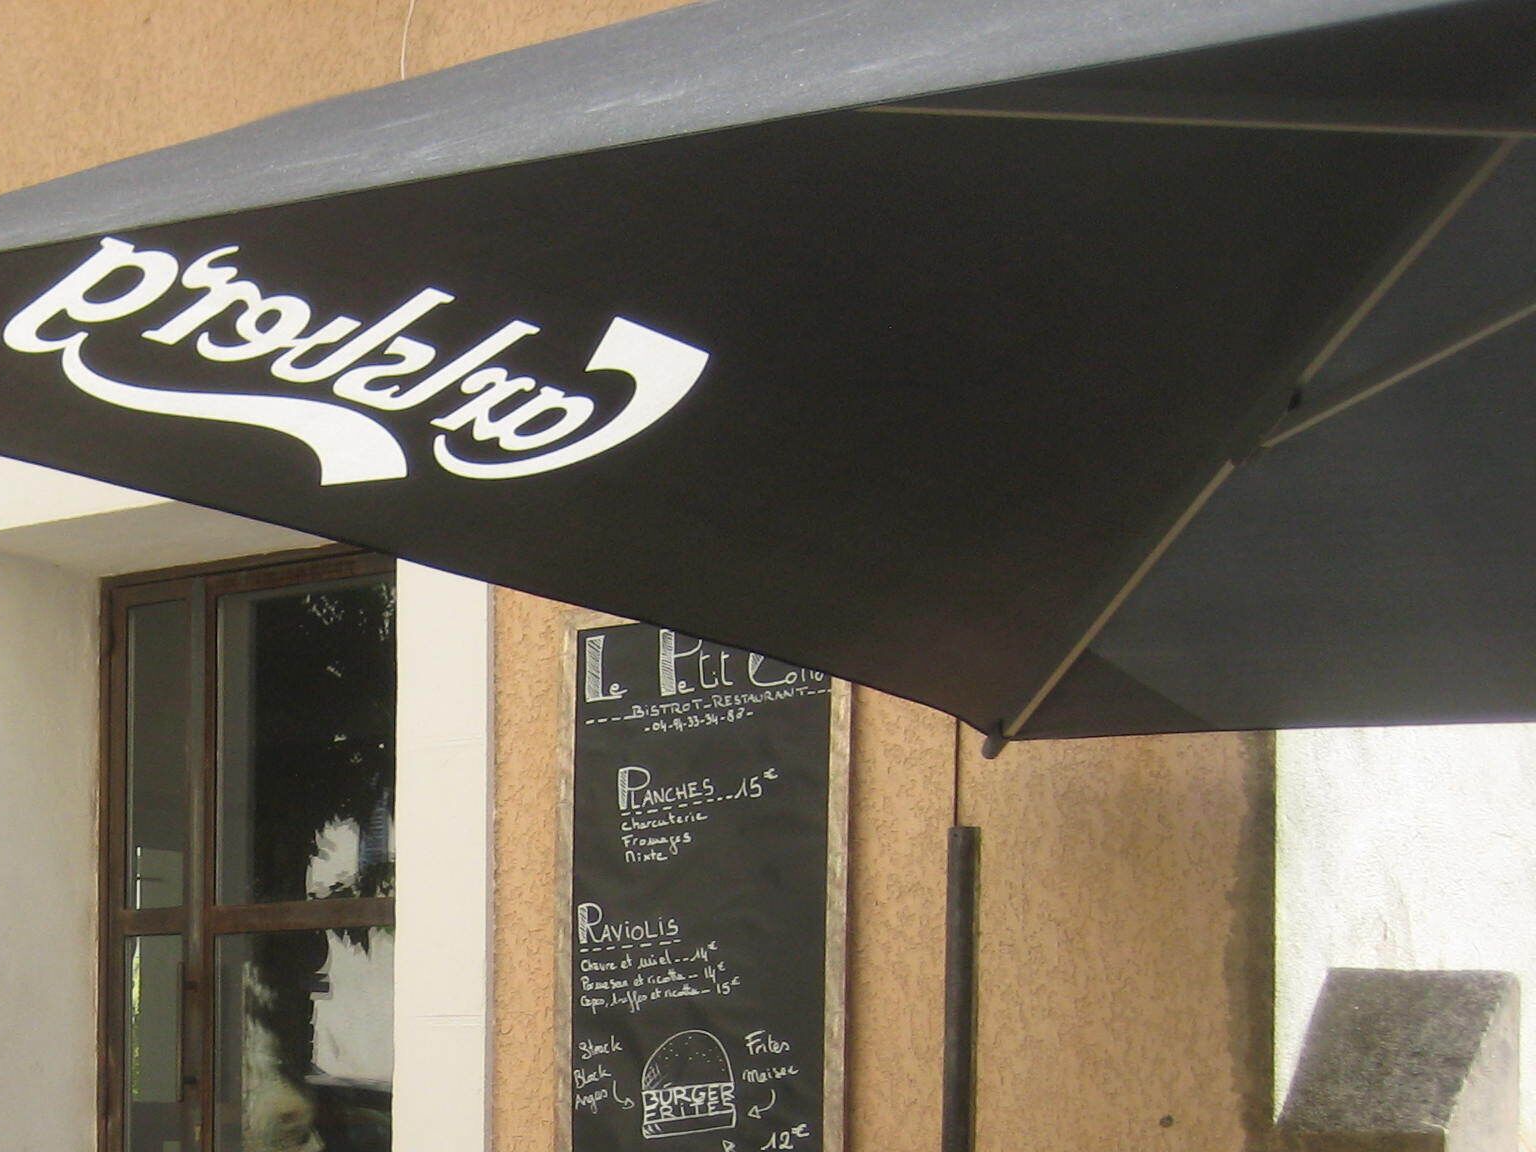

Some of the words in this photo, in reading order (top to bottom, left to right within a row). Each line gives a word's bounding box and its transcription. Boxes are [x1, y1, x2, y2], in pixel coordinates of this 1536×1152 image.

[585, 634, 628, 702] Le
[659, 627, 734, 697] Petit
[617, 766, 715, 810] PLANCHES
[621, 831, 692, 855] Fromages
[620, 953, 633, 969] et
[633, 973, 644, 987] et
[650, 987, 662, 1000] et
[745, 1029, 790, 1055] Frites
[642, 1082, 736, 1112] BURGER
